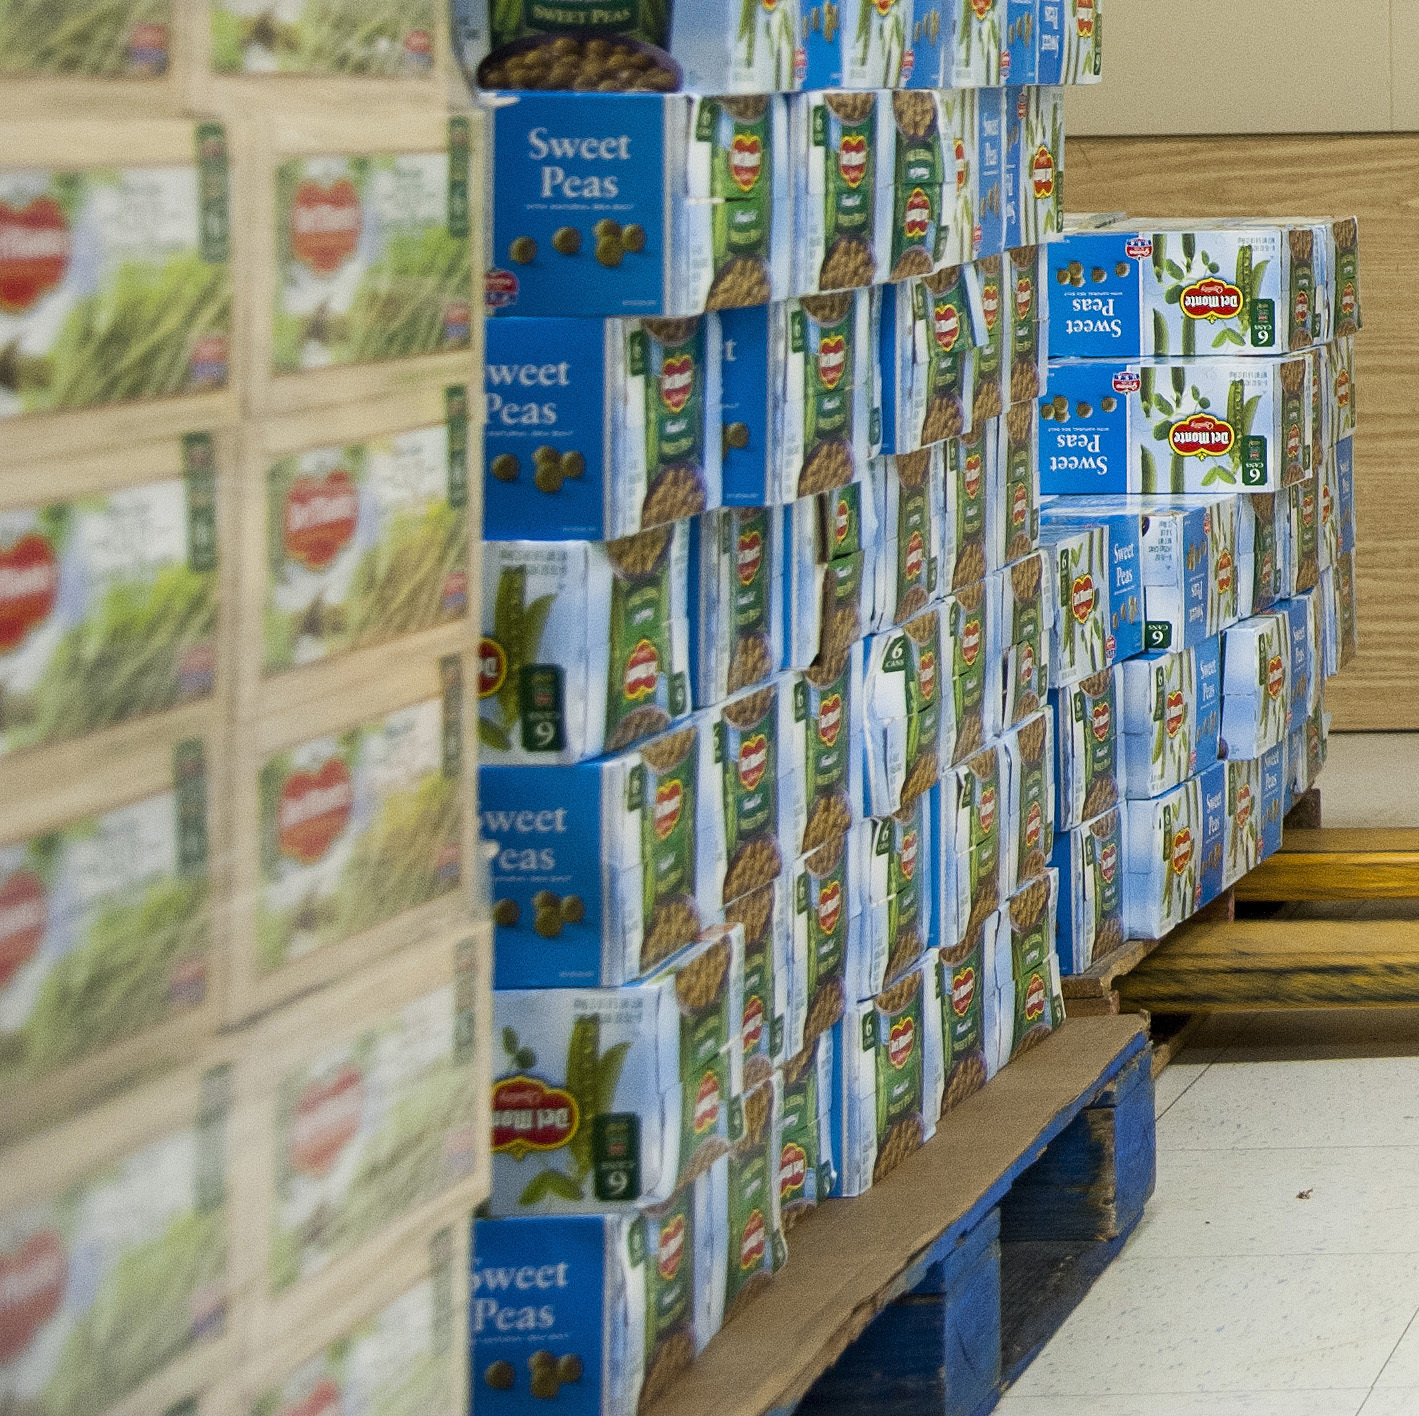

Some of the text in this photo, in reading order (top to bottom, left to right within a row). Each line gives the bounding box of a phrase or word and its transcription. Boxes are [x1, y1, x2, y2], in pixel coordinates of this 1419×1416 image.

[527, 127, 631, 161] Sweet
[541, 166, 619, 198] Peas
[1073, 299, 1114, 316] Peas
[1184, 295, 1238, 308] Del Monte
[1065, 319, 1122, 337] Sweet
[1257, 331, 1269, 345] 6
[485, 361, 570, 386] weet
[1057, 434, 1099, 452] Peas
[1173, 431, 1229, 444] Del Monte
[1050, 456, 1108, 475] Sweet
[1249, 468, 1260, 483] 6
[1113, 543, 1135, 564] Sweet
[1116, 567, 1133, 587] Peas
[1152, 630, 1164, 646] 6
[534, 722, 555, 746] 6
[484, 808, 567, 833] weet
[500, 849, 555, 871] eas
[608, 1172, 628, 1195] 6
[474, 1298, 554, 1331] Peas
